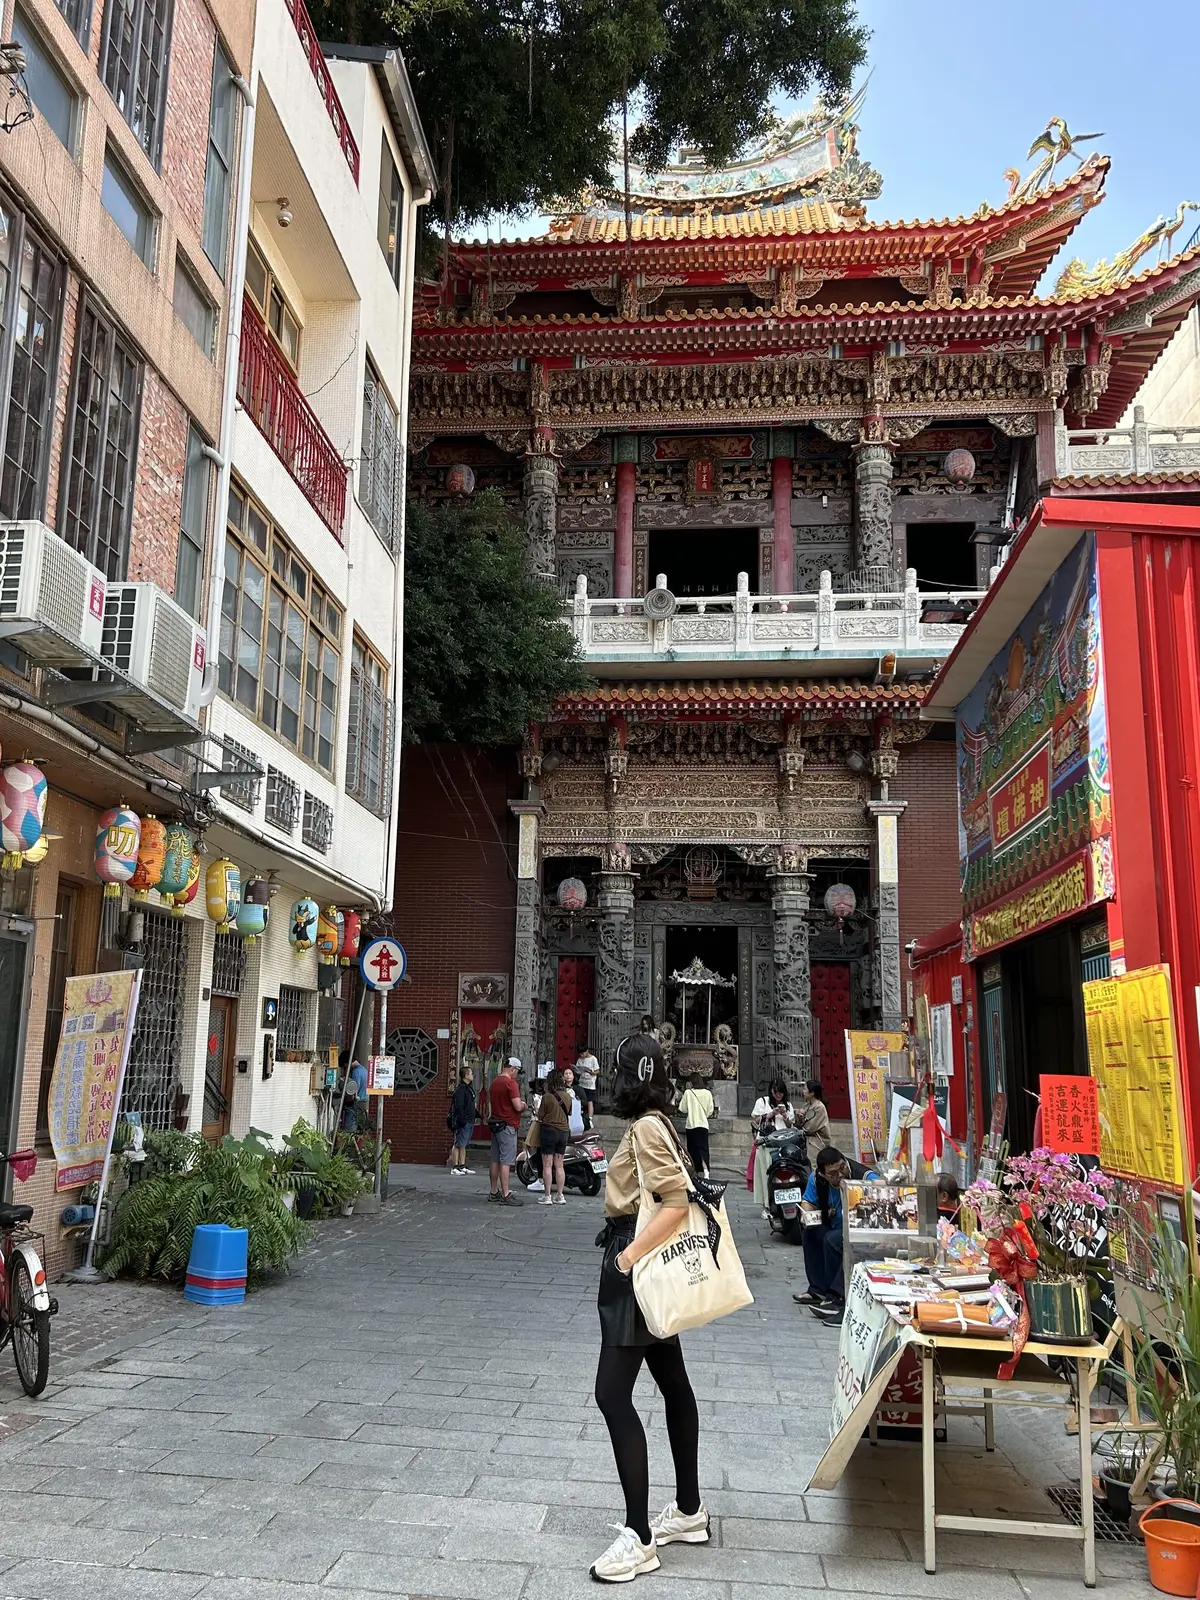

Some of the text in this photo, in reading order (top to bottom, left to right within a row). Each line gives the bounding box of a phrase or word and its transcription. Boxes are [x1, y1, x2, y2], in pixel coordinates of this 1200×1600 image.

[996, 776, 1044, 838] 神佛壇
[381, 958, 389, 979] 救火栓
[857, 1072, 871, 1139] 建廟募款
[1055, 1084, 1070, 1142] 吉運龍來
[1068, 1085, 1083, 1143] 香火鼎盛
[679, 1230, 690, 1240] THE
